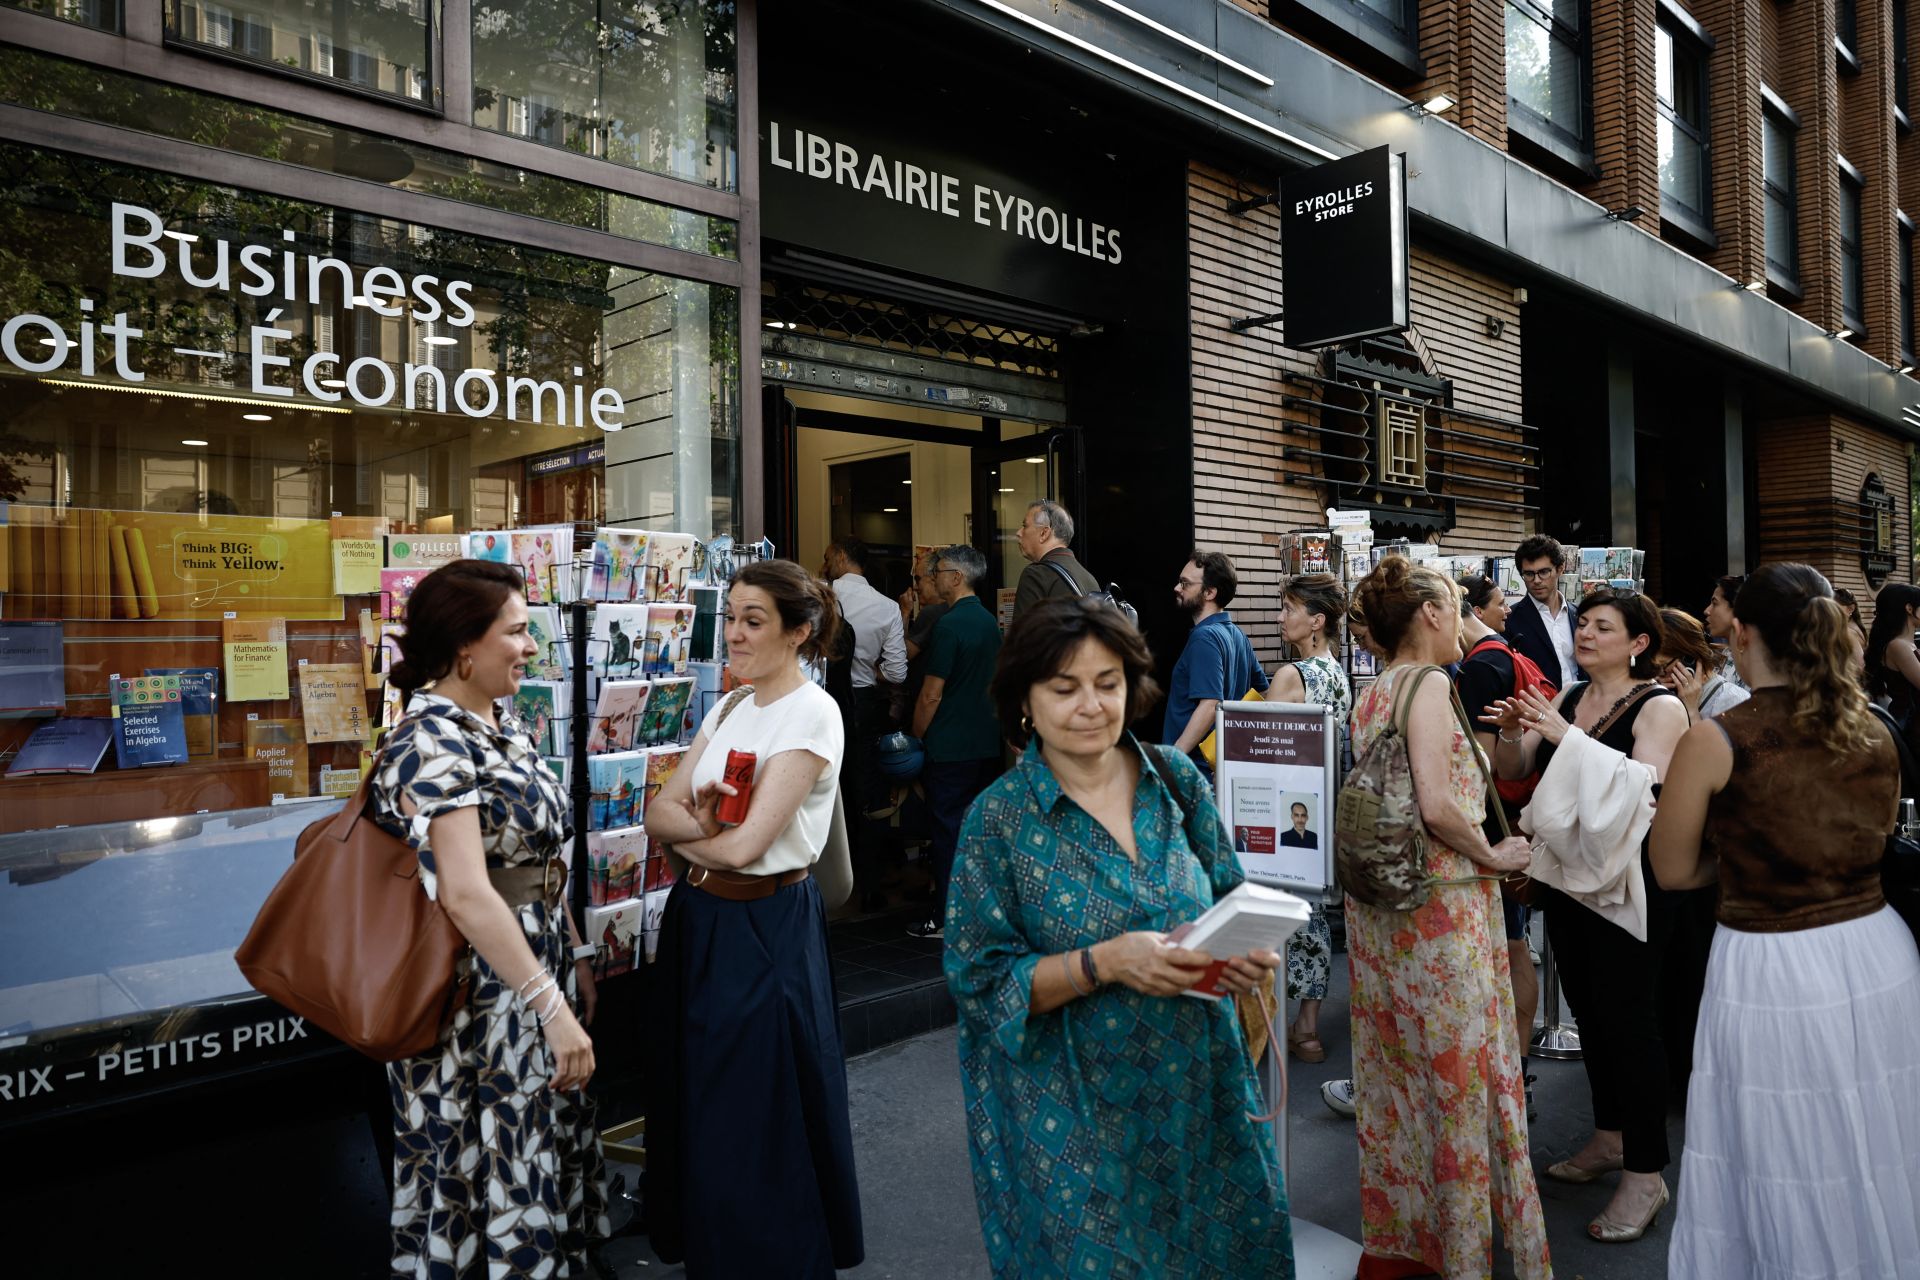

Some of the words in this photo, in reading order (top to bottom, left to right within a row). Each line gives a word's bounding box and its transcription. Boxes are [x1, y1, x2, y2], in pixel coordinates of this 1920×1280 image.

[770, 121, 960, 218] LIBRAIRIE
[974, 184, 1123, 265] EYROLLES
[1295, 181, 1373, 216] EYROLLES
[1314, 203, 1354, 222] STORE
[111, 201, 475, 329] Business
[250, 307, 625, 432] Économie
[182, 543, 216, 553] Think
[220, 542, 252, 554] BIG:
[341, 541, 363, 549] Worlds
[341, 549, 348, 557] of
[349, 549, 375, 559] Nothing
[182, 559, 216, 568] Think
[221, 556, 284, 570] Yellow.
[233, 644, 278, 653] Mathematics
[233, 653, 244, 662] for
[245, 653, 272, 662] Finance
[307, 681, 334, 690] Further
[308, 691, 337, 700] Algebra
[123, 715, 158, 726] Selected
[1224, 719, 1271, 730] RENCONTRE
[1272, 722, 1282, 730] ET
[124, 726, 161, 736] Exercises
[125, 737, 134, 746] in
[136, 735, 167, 747] Algebra
[1253, 735, 1270, 744] Jeudi
[1280, 737, 1294, 745] mai
[255, 747, 286, 759] Applied
[1254, 747, 1273, 756] partir
[268, 758, 294, 766] dictive
[268, 768, 293, 778] deling
[99, 1032, 221, 1081] PETITS
[232, 1016, 308, 1052] PRIX
